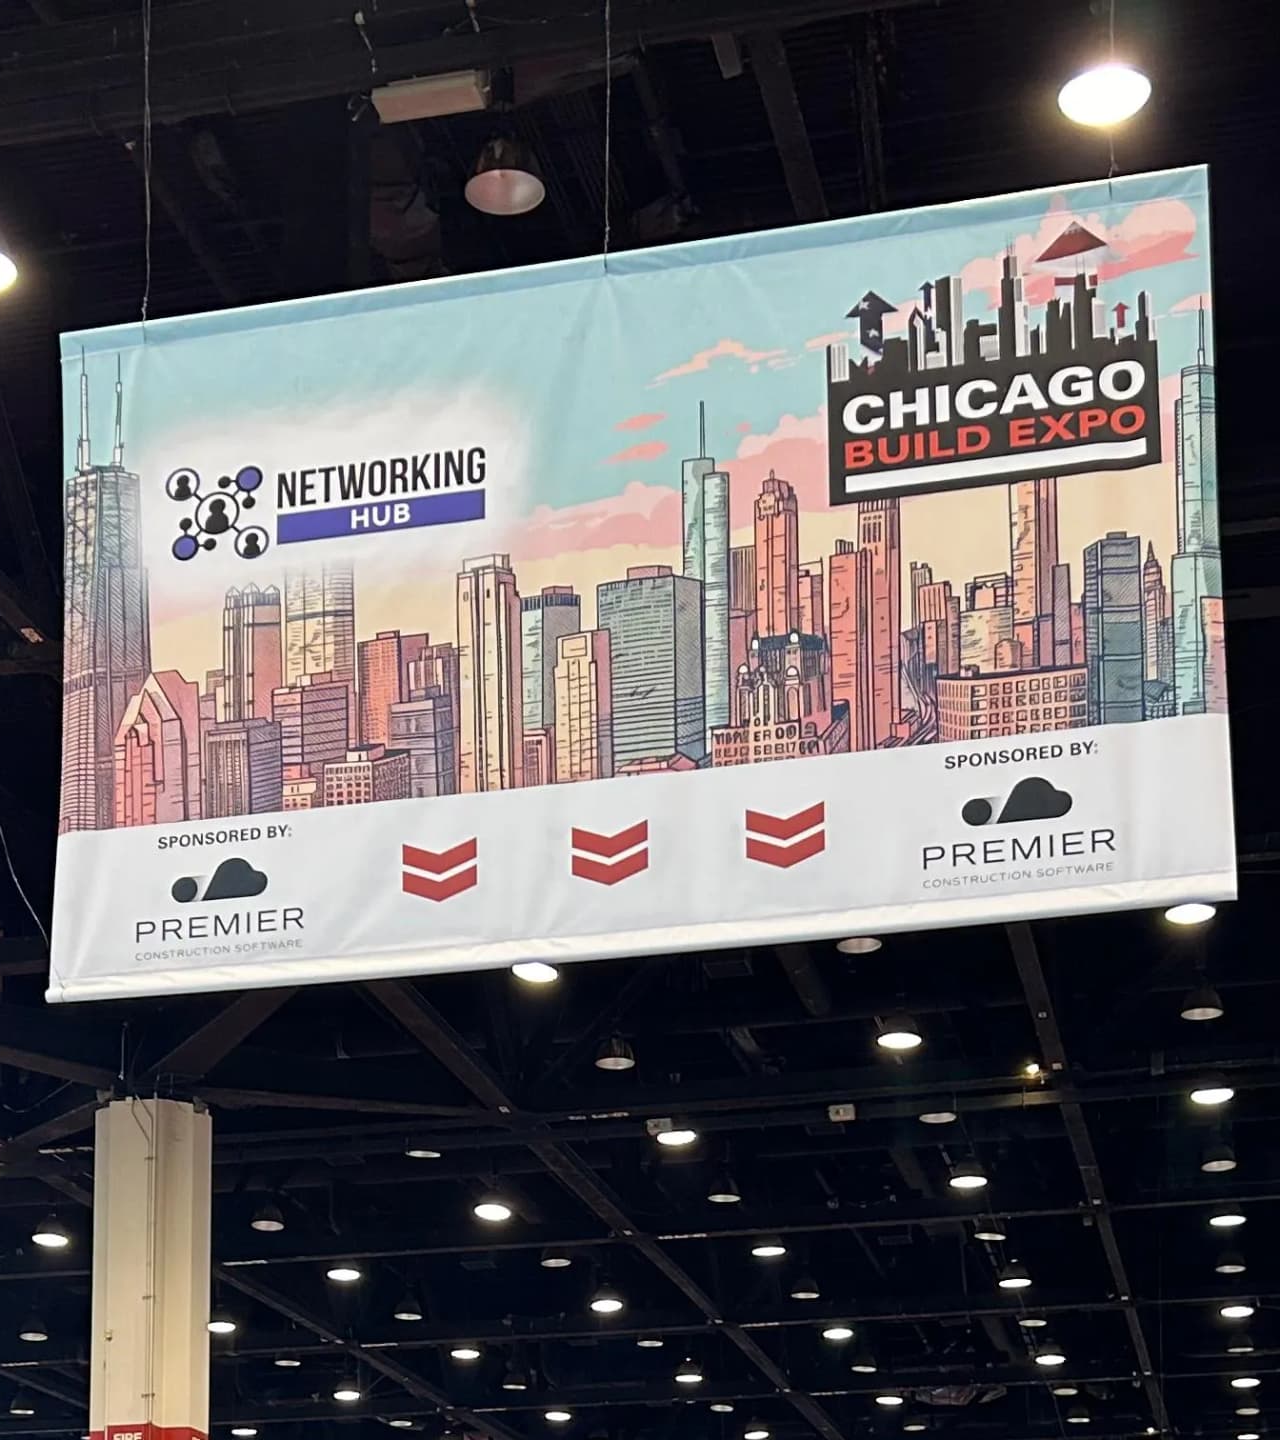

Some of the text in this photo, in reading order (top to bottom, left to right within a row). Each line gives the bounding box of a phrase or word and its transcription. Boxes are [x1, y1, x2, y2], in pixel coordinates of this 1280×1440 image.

[842, 359, 1146, 435] CHICAGO
[844, 404, 1147, 470] BUILD EXPO
[277, 446, 486, 509] NETWORKING
[350, 502, 411, 530] HUB
[944, 740, 1099, 770] SPONSORED BY:
[157, 824, 293, 850] SPONSORED BY:
[922, 828, 1117, 871] PREMIER
[922, 862, 1115, 889] CONSTRUCTION SOFTWARE
[135, 907, 305, 943] PREMIER
[135, 939, 303, 962] CONSTRUCTION SOFTWARE
